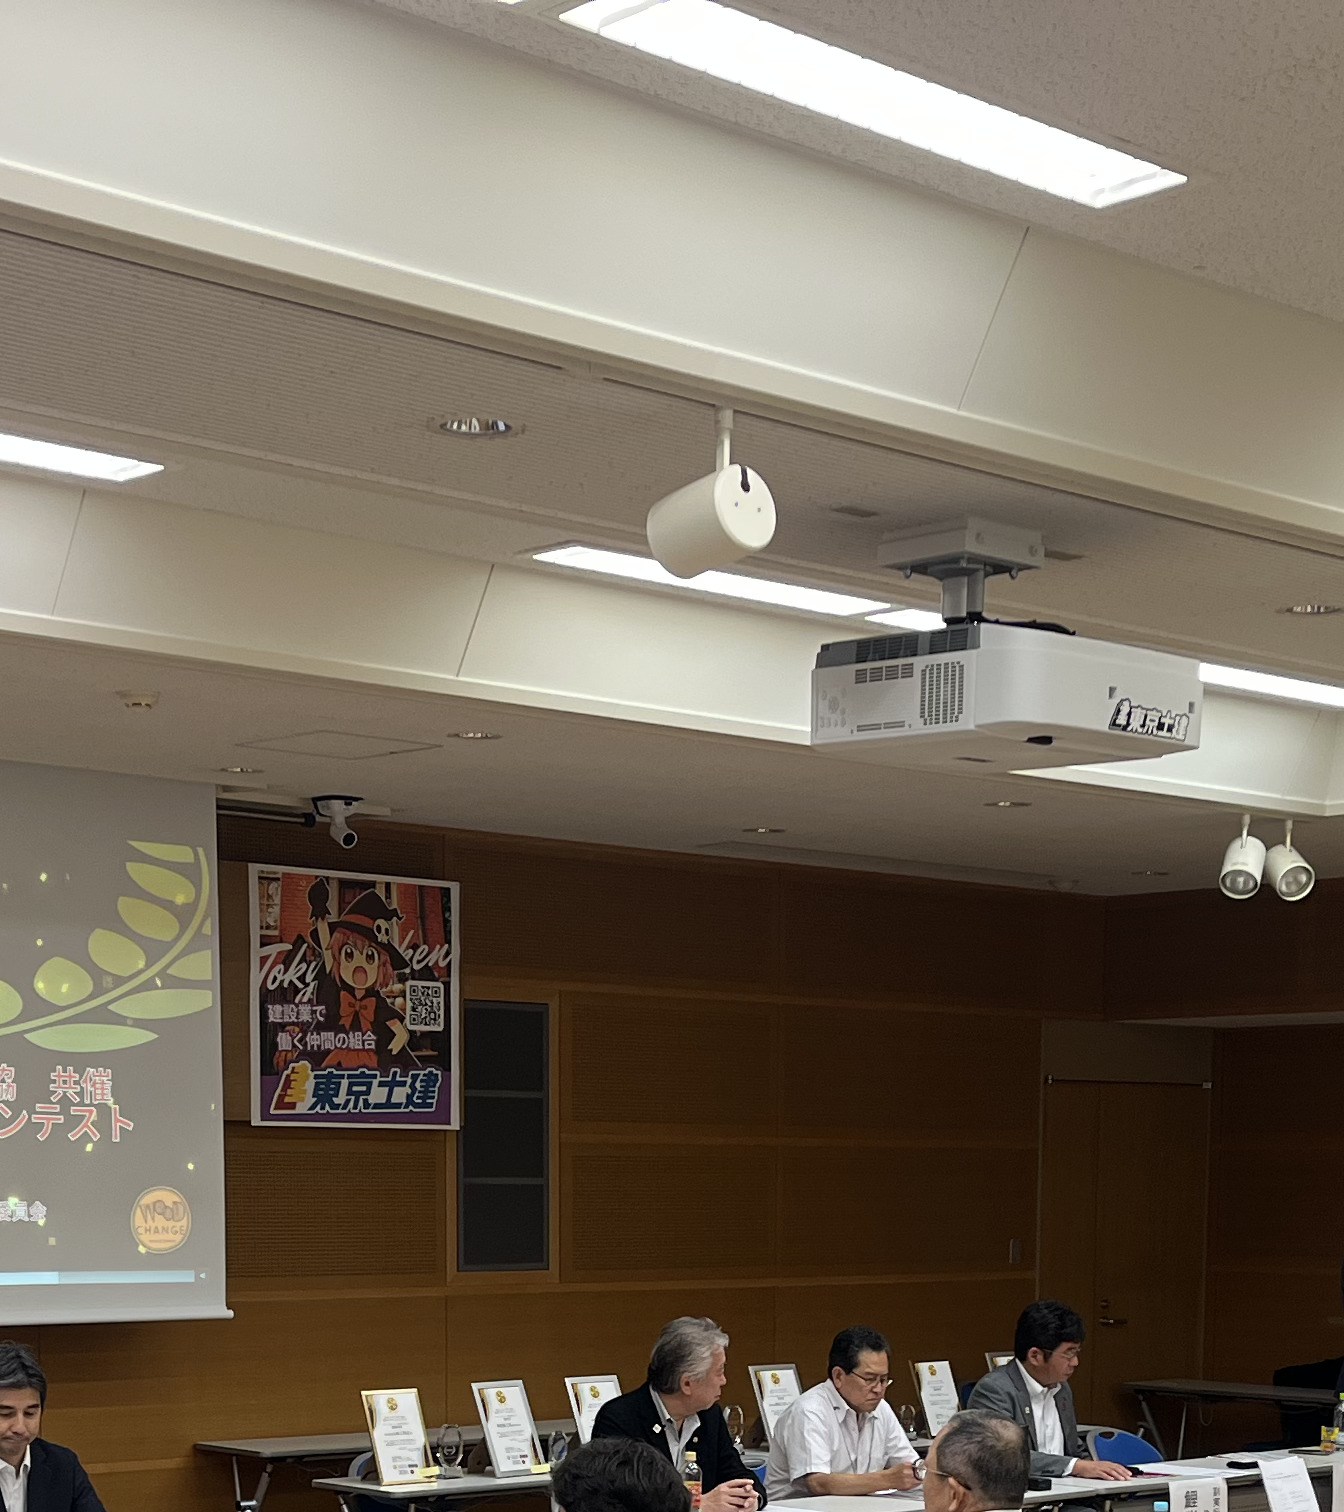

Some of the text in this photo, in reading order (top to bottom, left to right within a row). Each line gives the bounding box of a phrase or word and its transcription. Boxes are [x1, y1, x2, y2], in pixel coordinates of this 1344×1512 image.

[267, 1003, 326, 1023] 建設業で
[277, 1031, 376, 1050] 働く仲間の組合
[50, 1065, 113, 1104] 共催
[307, 1067, 442, 1113] 東京土建
[136, 1225, 186, 1235] CHANGE
